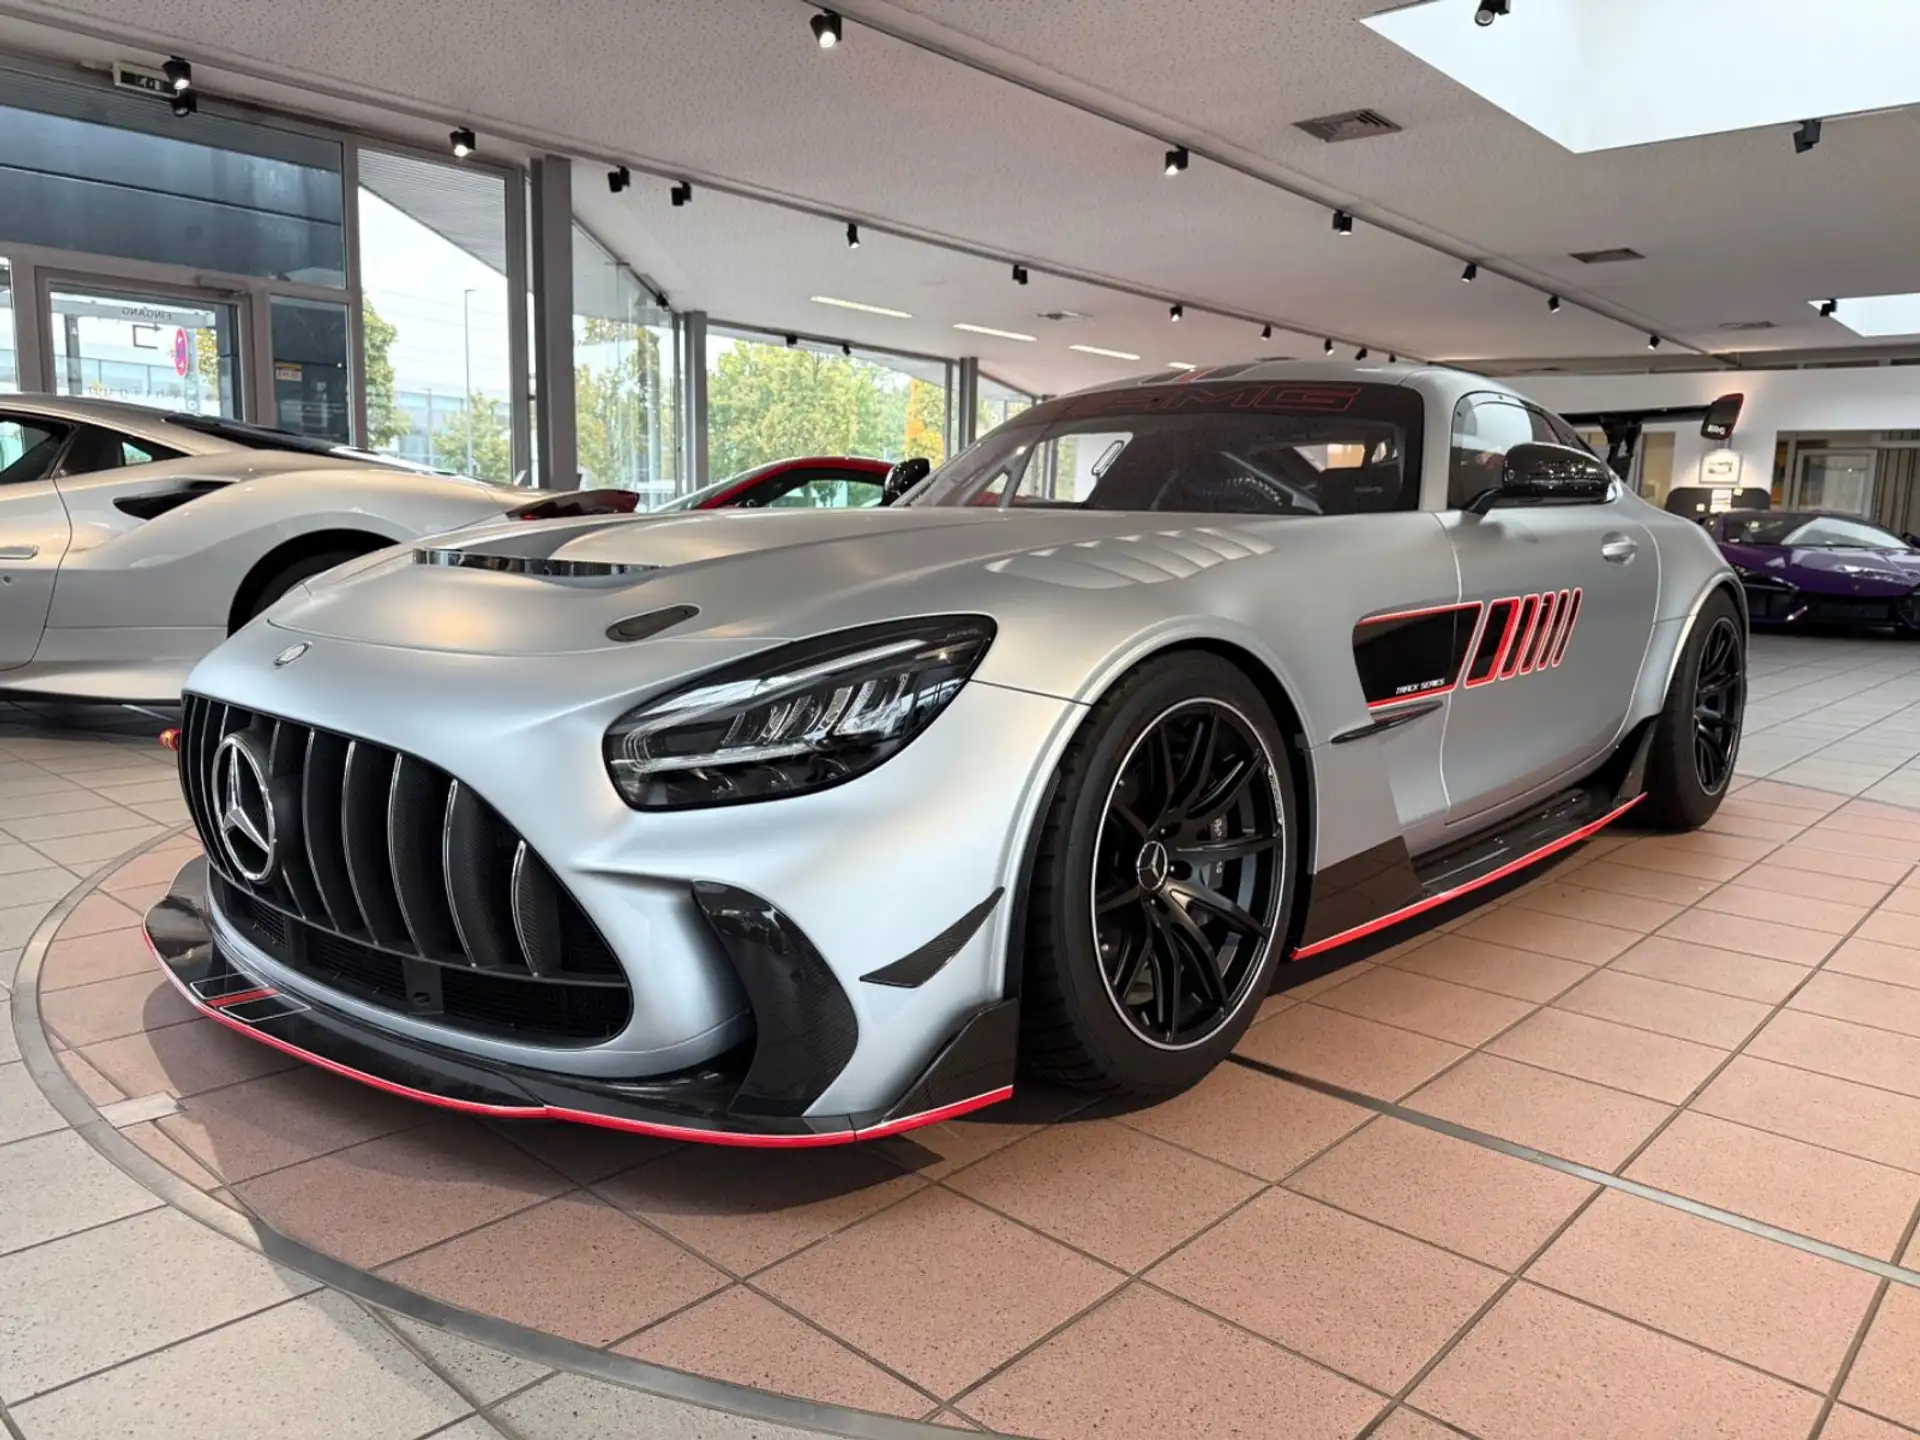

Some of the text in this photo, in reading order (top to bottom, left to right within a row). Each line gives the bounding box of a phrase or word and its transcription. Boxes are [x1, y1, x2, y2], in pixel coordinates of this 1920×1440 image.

[1064, 384, 1361, 416] AMG
[1395, 677, 1445, 695] TRACK SERIES
